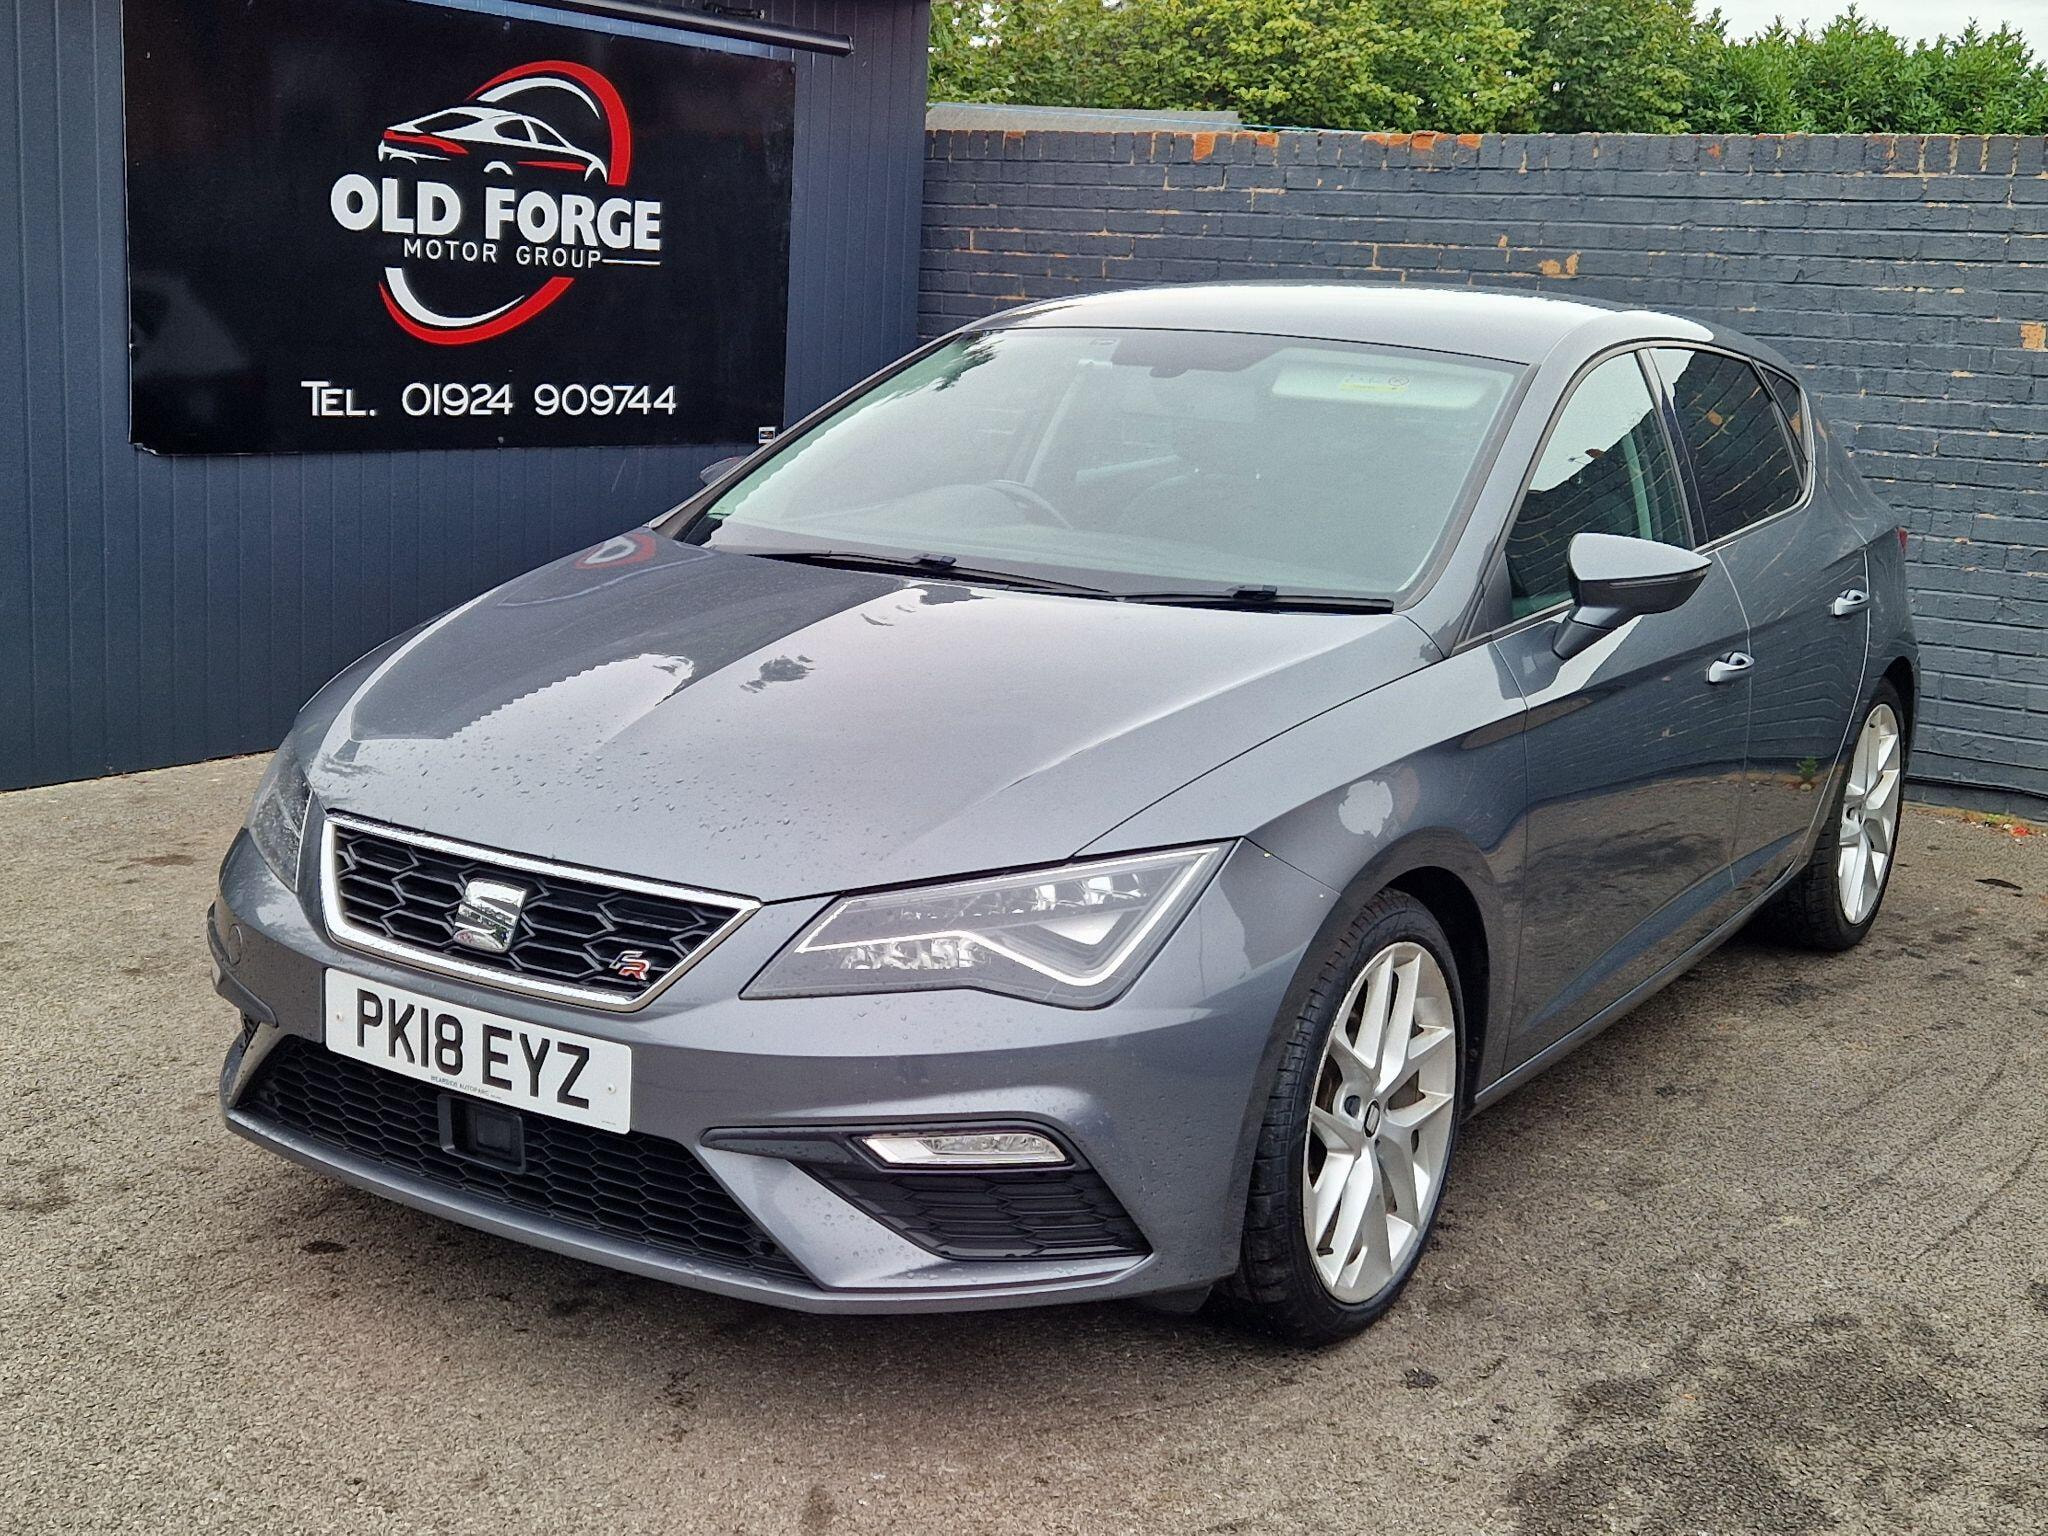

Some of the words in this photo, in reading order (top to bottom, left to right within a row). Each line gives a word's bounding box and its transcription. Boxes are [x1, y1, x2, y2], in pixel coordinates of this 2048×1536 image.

[330, 173, 462, 236] OLD
[485, 187, 662, 251] FORGE
[403, 238, 497, 264] MOTOR
[515, 245, 601, 269] GROUP
[301, 380, 377, 417] TEL.
[401, 382, 513, 416] 01924
[534, 383, 677, 416] 909744
[357, 988, 464, 1077] PK18
[482, 1023, 590, 1110] EYZ
